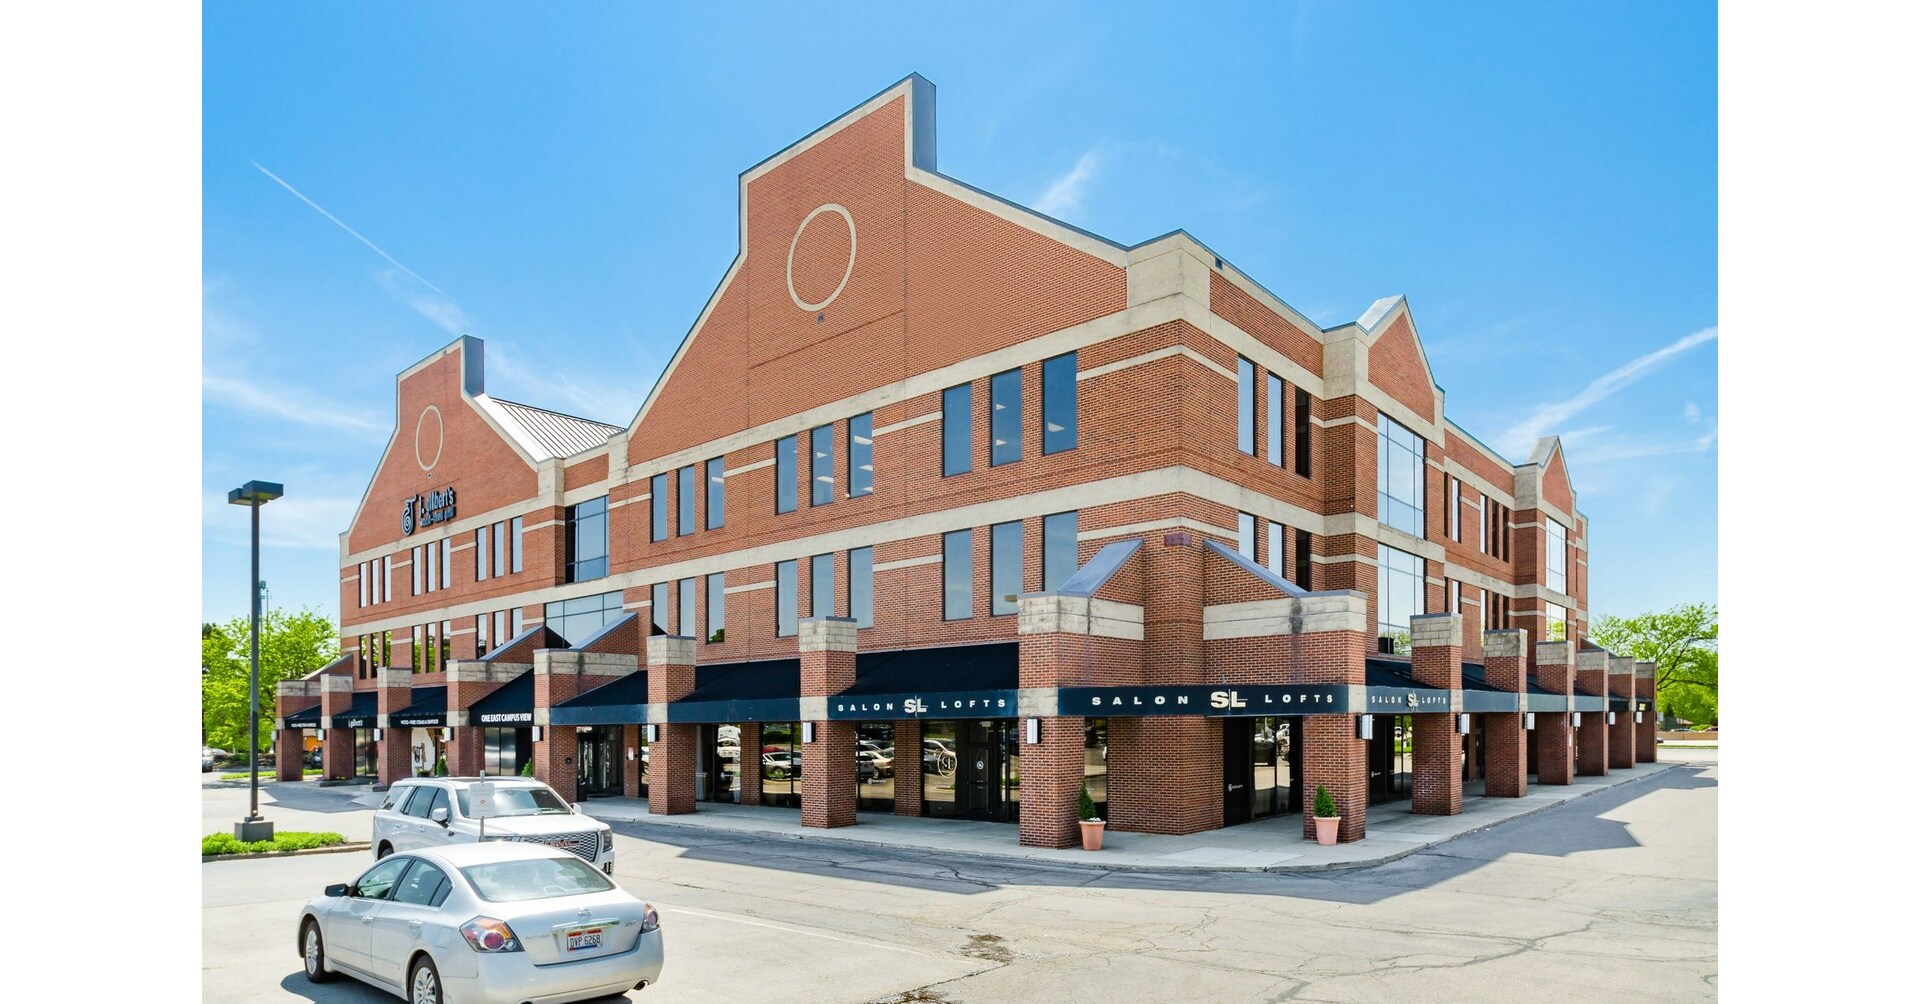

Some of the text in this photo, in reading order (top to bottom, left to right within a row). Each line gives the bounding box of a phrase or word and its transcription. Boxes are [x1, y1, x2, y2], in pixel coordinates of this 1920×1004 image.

[837, 703, 893, 712] SALON
[941, 699, 1006, 709] LOFTS
[1091, 695, 1188, 706] SALON
[1264, 694, 1333, 703] LOFTS
[1371, 695, 1402, 704] SALON
[1421, 696, 1446, 704] LOFTS
[481, 713, 532, 722] ONE EAST CAMPUS VIEW
[584, 934, 600, 946] 6268
